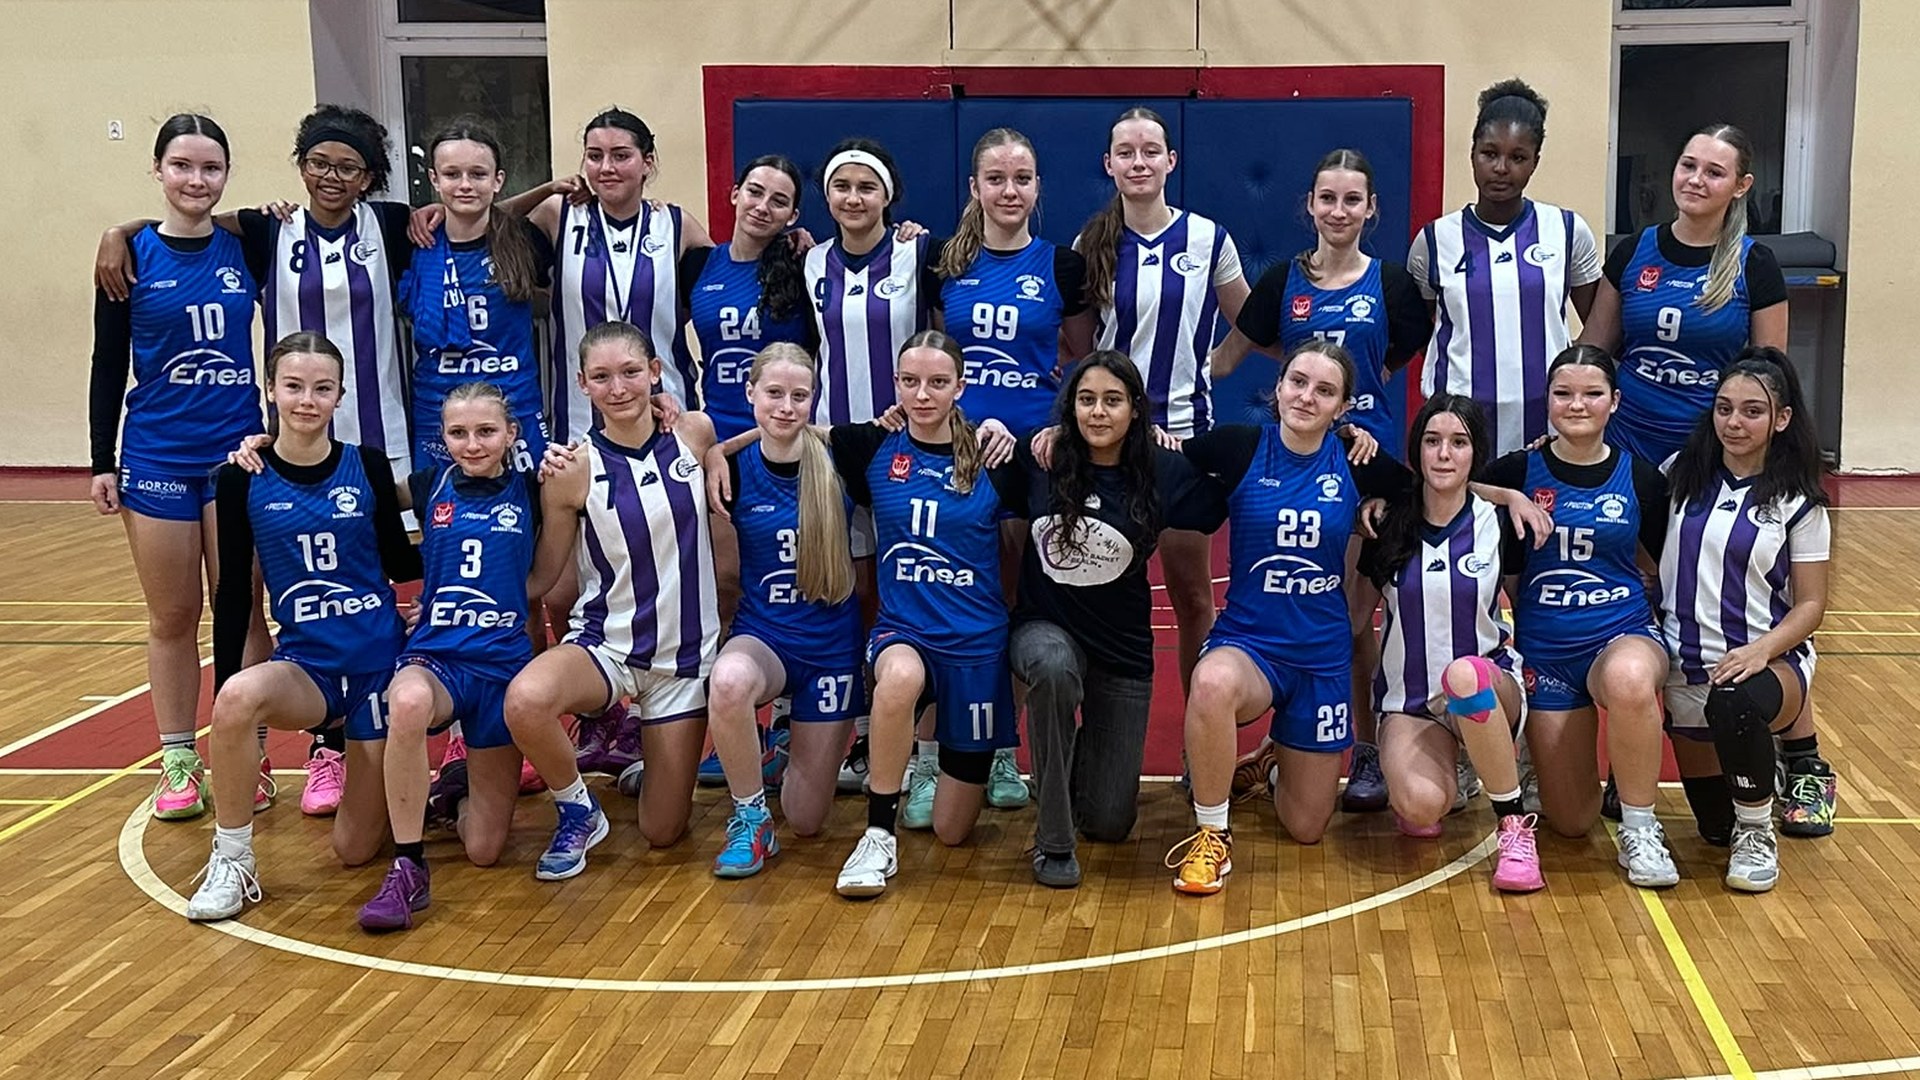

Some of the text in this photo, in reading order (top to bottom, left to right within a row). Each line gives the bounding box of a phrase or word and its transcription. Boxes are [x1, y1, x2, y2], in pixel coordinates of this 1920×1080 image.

[289, 240, 308, 273] 8
[1454, 250, 1476, 278] 4
[815, 277, 832, 313] 9
[185, 303, 225, 342] 10
[720, 306, 762, 341] 24
[972, 303, 1019, 341] 99
[1657, 307, 1682, 342] 9
[169, 363, 251, 386] Enea
[438, 352, 519, 374] Enea
[717, 362, 752, 383] En
[963, 360, 1039, 388] Enea
[1636, 358, 1719, 386] Enea
[137, 479, 187, 493] GORZÓW
[595, 472, 616, 510] 7
[910, 498, 939, 538] 11
[1276, 508, 1321, 548] 23
[297, 532, 338, 572] 13
[460, 539, 483, 579] 3
[776, 528, 800, 563] 3
[1556, 526, 1595, 562] 15
[896, 557, 974, 587] Enea
[1263, 570, 1341, 595] Enea
[294, 592, 382, 623] Enea
[769, 583, 807, 604] En
[1538, 584, 1630, 607] Enea
[430, 601, 518, 628] Enea
[368, 692, 389, 730] 1
[817, 674, 853, 713] 37
[969, 702, 993, 740] 11
[1316, 702, 1348, 742] 23
